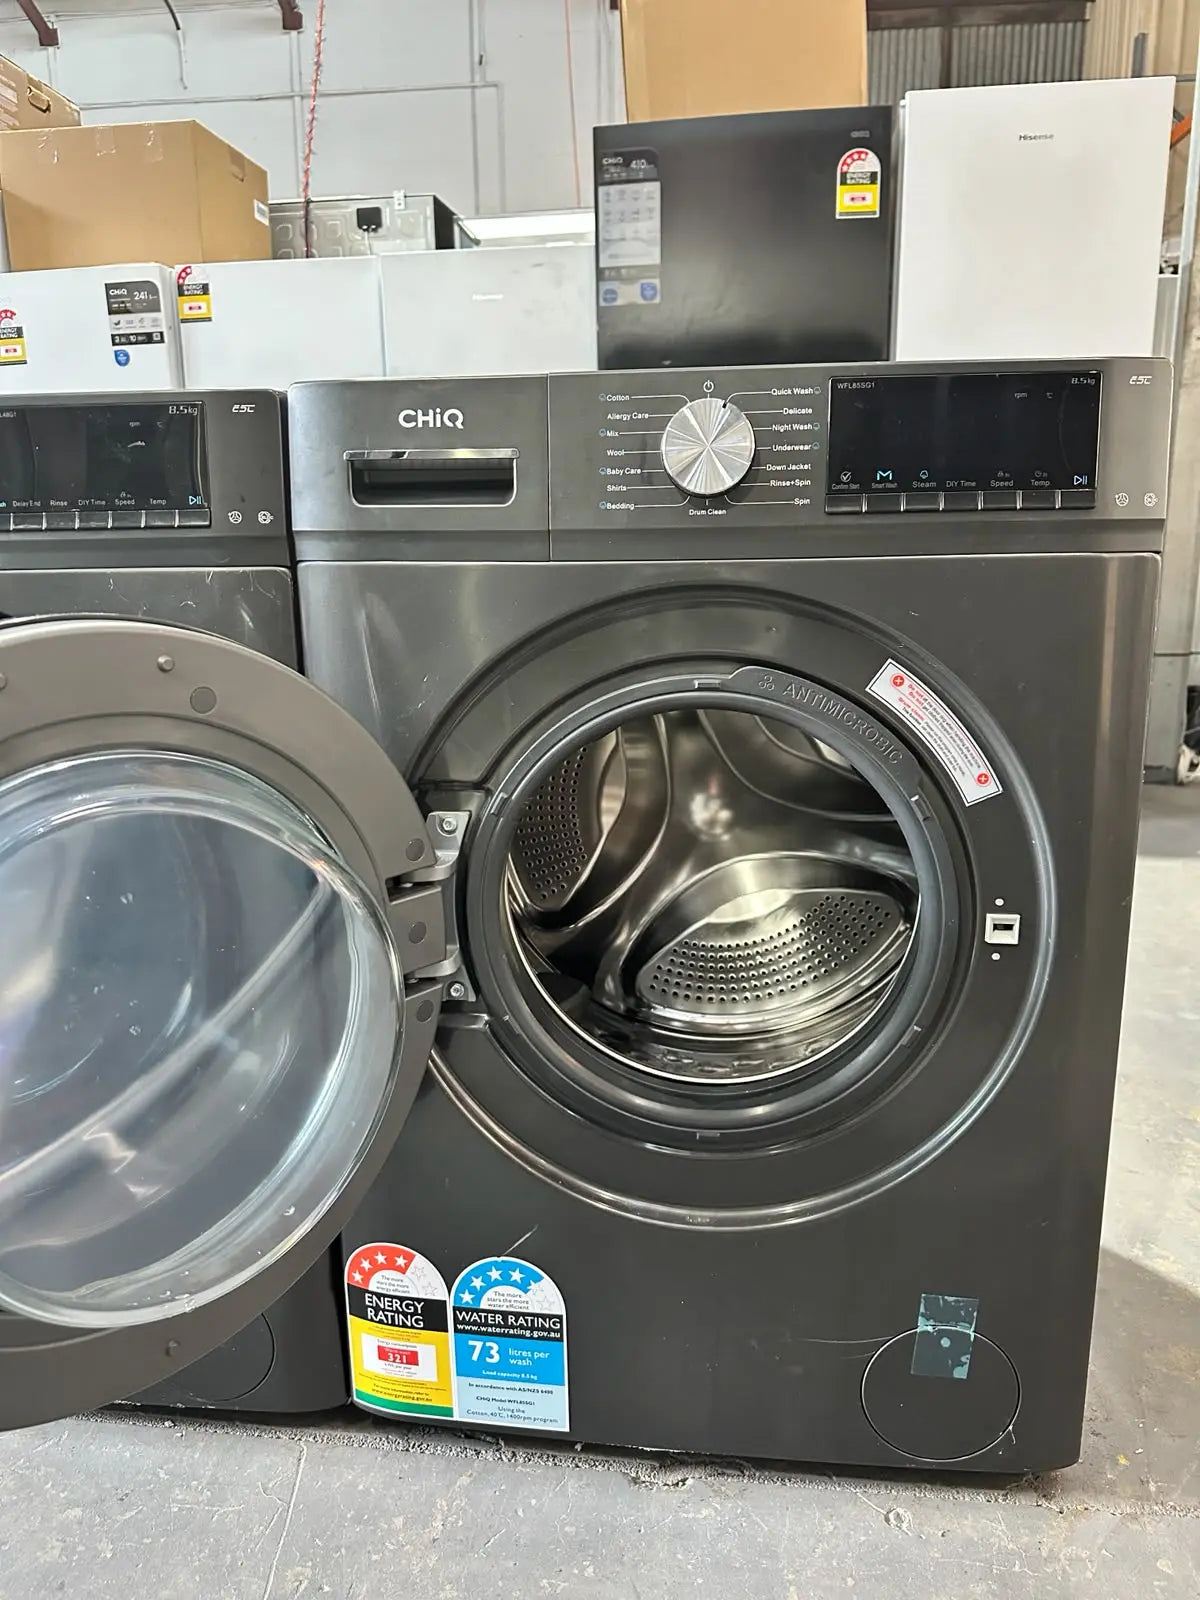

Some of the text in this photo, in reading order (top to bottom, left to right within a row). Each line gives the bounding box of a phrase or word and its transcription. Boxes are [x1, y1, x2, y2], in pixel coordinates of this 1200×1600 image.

[134, 291, 148, 300] 241
[771, 388, 792, 396] Quick
[398, 407, 464, 430] CHiQ
[607, 412, 631, 420] Allergy
[772, 424, 790, 432] Night
[606, 468, 624, 476] Baby
[770, 480, 811, 488] Rinse+Spin
[912, 480, 936, 488] Steam
[1030, 479, 1050, 487] Temp
[607, 502, 634, 510] Bedding
[794, 498, 810, 506] Spin
[782, 683, 902, 764] ANTIMICROBIC
[364, 1292, 424, 1314] ENERGY
[367, 1308, 424, 1328] RATING
[456, 1310, 560, 1329] WATER RATING
[456, 1323, 560, 1338] www.waterrating.gov.au
[468, 1340, 500, 1364] 73
[509, 1348, 550, 1361] litres per
[388, 1352, 407, 1363] 321
[509, 1357, 532, 1366] wash
